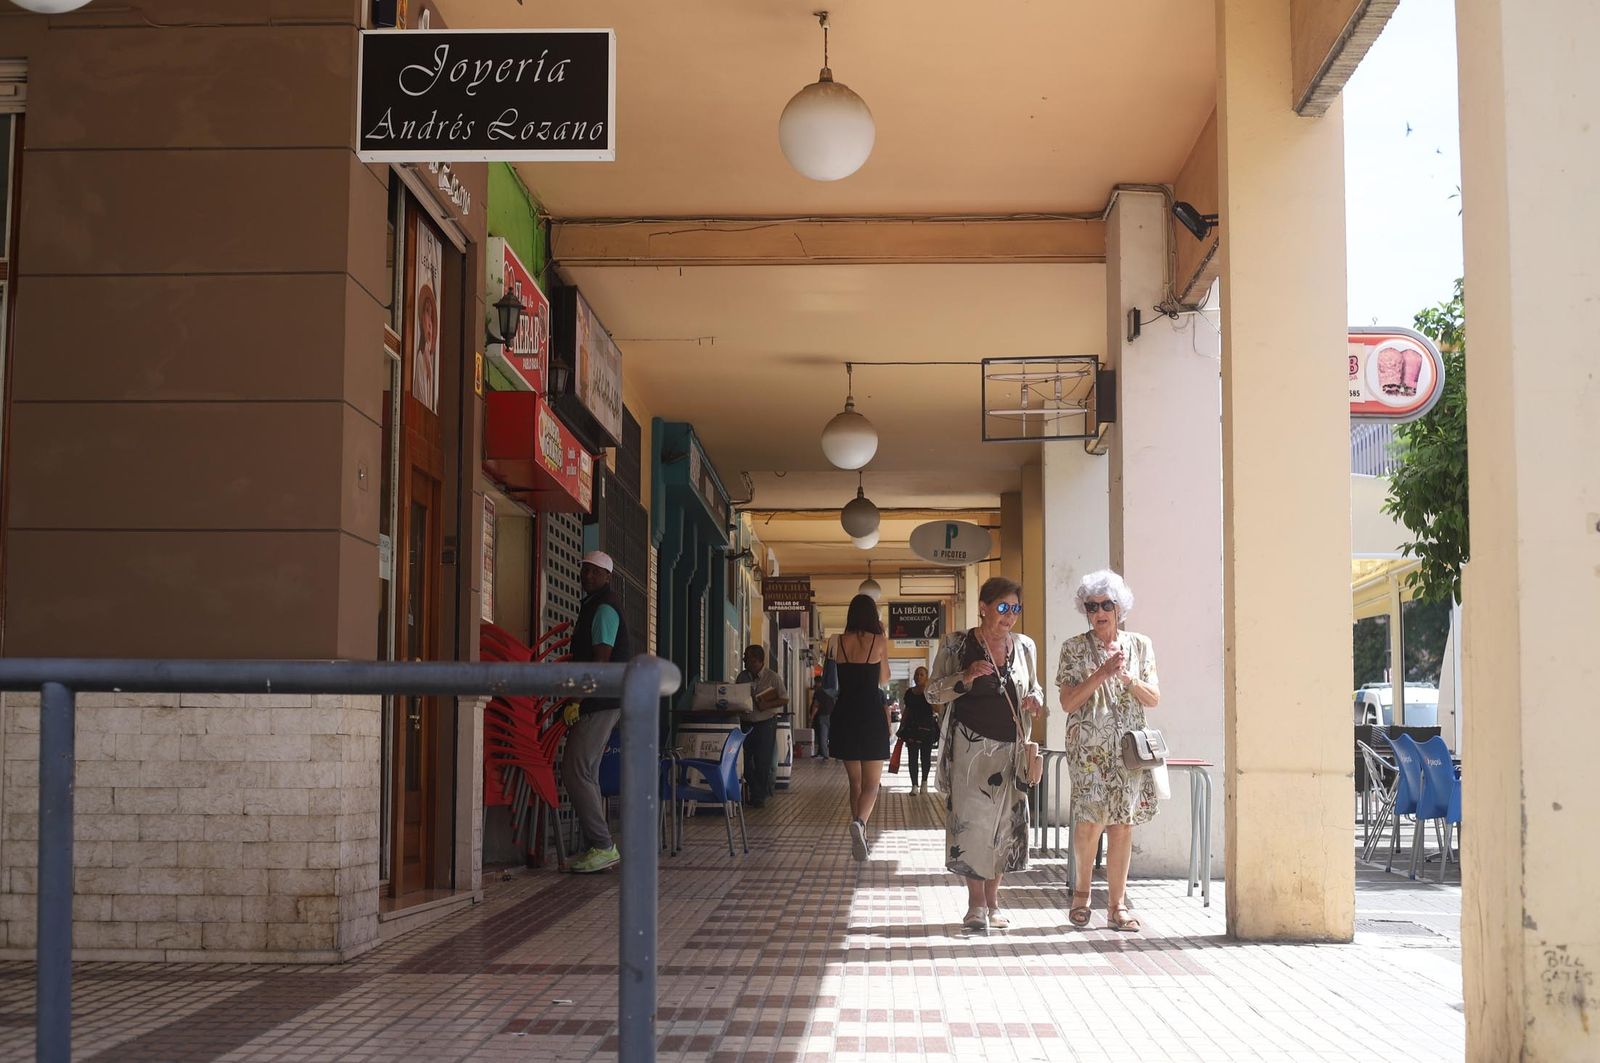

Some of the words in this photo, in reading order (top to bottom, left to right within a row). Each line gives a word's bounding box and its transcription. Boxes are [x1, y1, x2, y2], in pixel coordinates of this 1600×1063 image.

[399, 44, 571, 97] Joyería
[365, 107, 475, 141] Andrés
[487, 108, 604, 141] Lozano
[945, 523, 959, 549] P
[941, 550, 967, 559] PICOTEO
[904, 605, 938, 614] IBÉRICA
